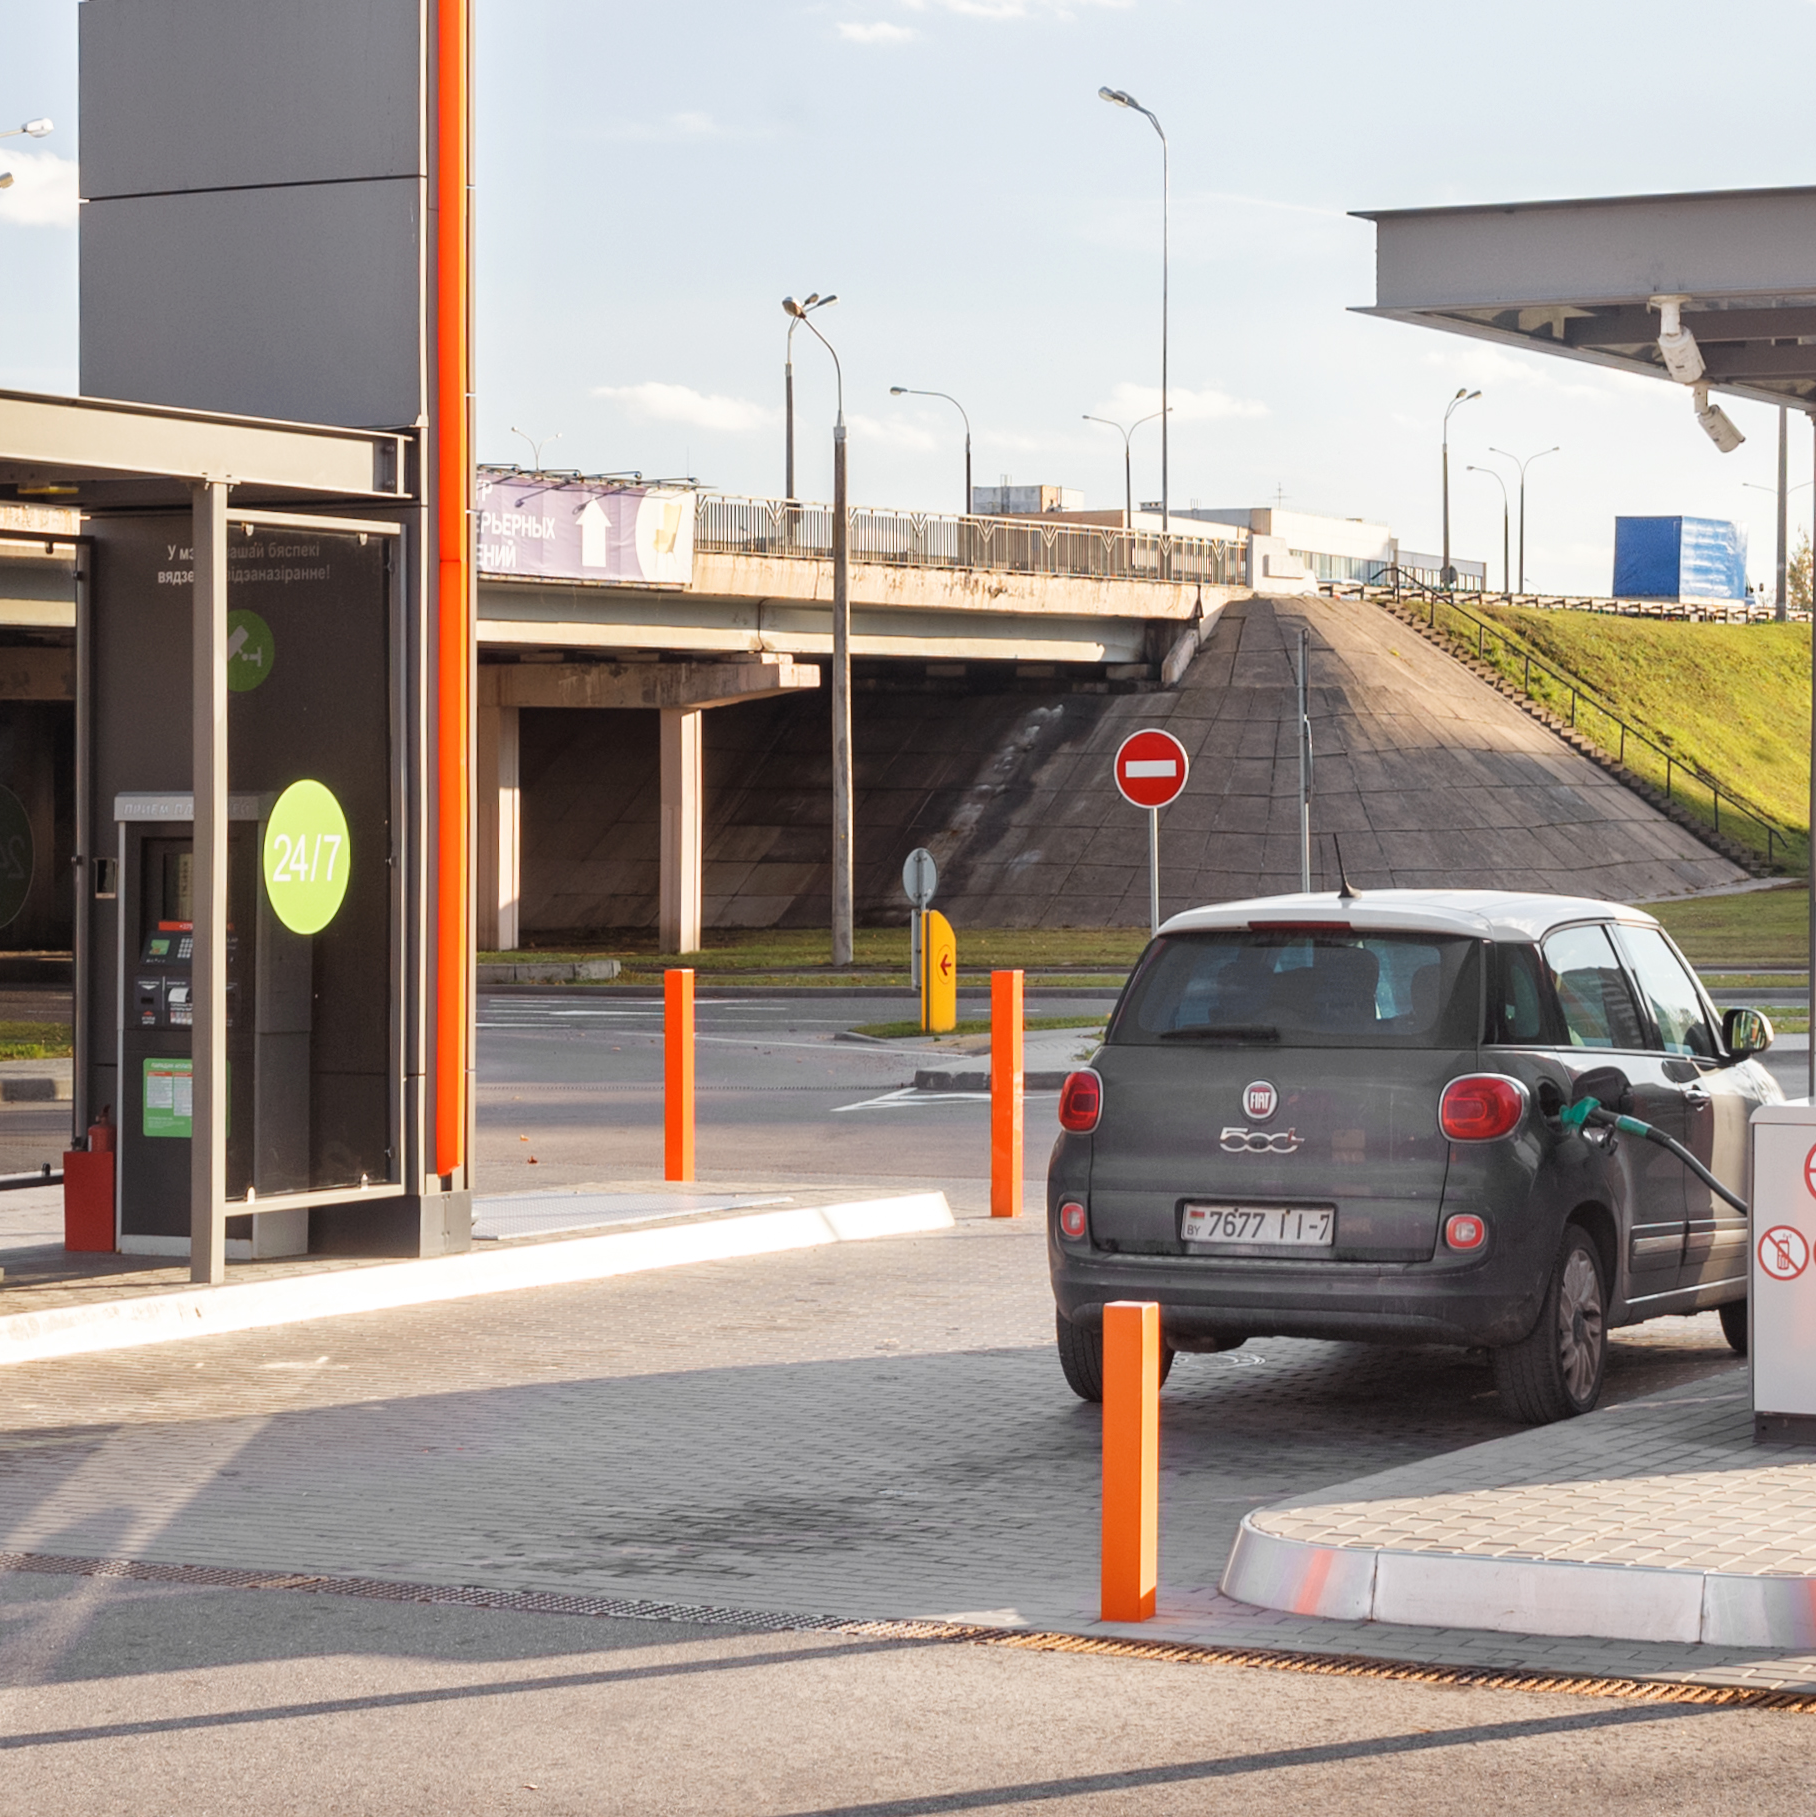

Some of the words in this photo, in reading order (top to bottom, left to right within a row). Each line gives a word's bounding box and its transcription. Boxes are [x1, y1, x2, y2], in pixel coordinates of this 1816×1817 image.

[476, 511, 556, 540] РЬЕРНЫХ
[167, 545, 176, 561] У
[268, 541, 320, 558] бяспекі
[157, 570, 194, 586] вядзе
[124, 803, 169, 816] ПРИЕМ
[273, 833, 342, 882] 24/7
[1250, 1091, 1271, 1110] FIAT
[1186, 1224, 1201, 1236] BY
[1208, 1210, 1266, 1239] 7677
